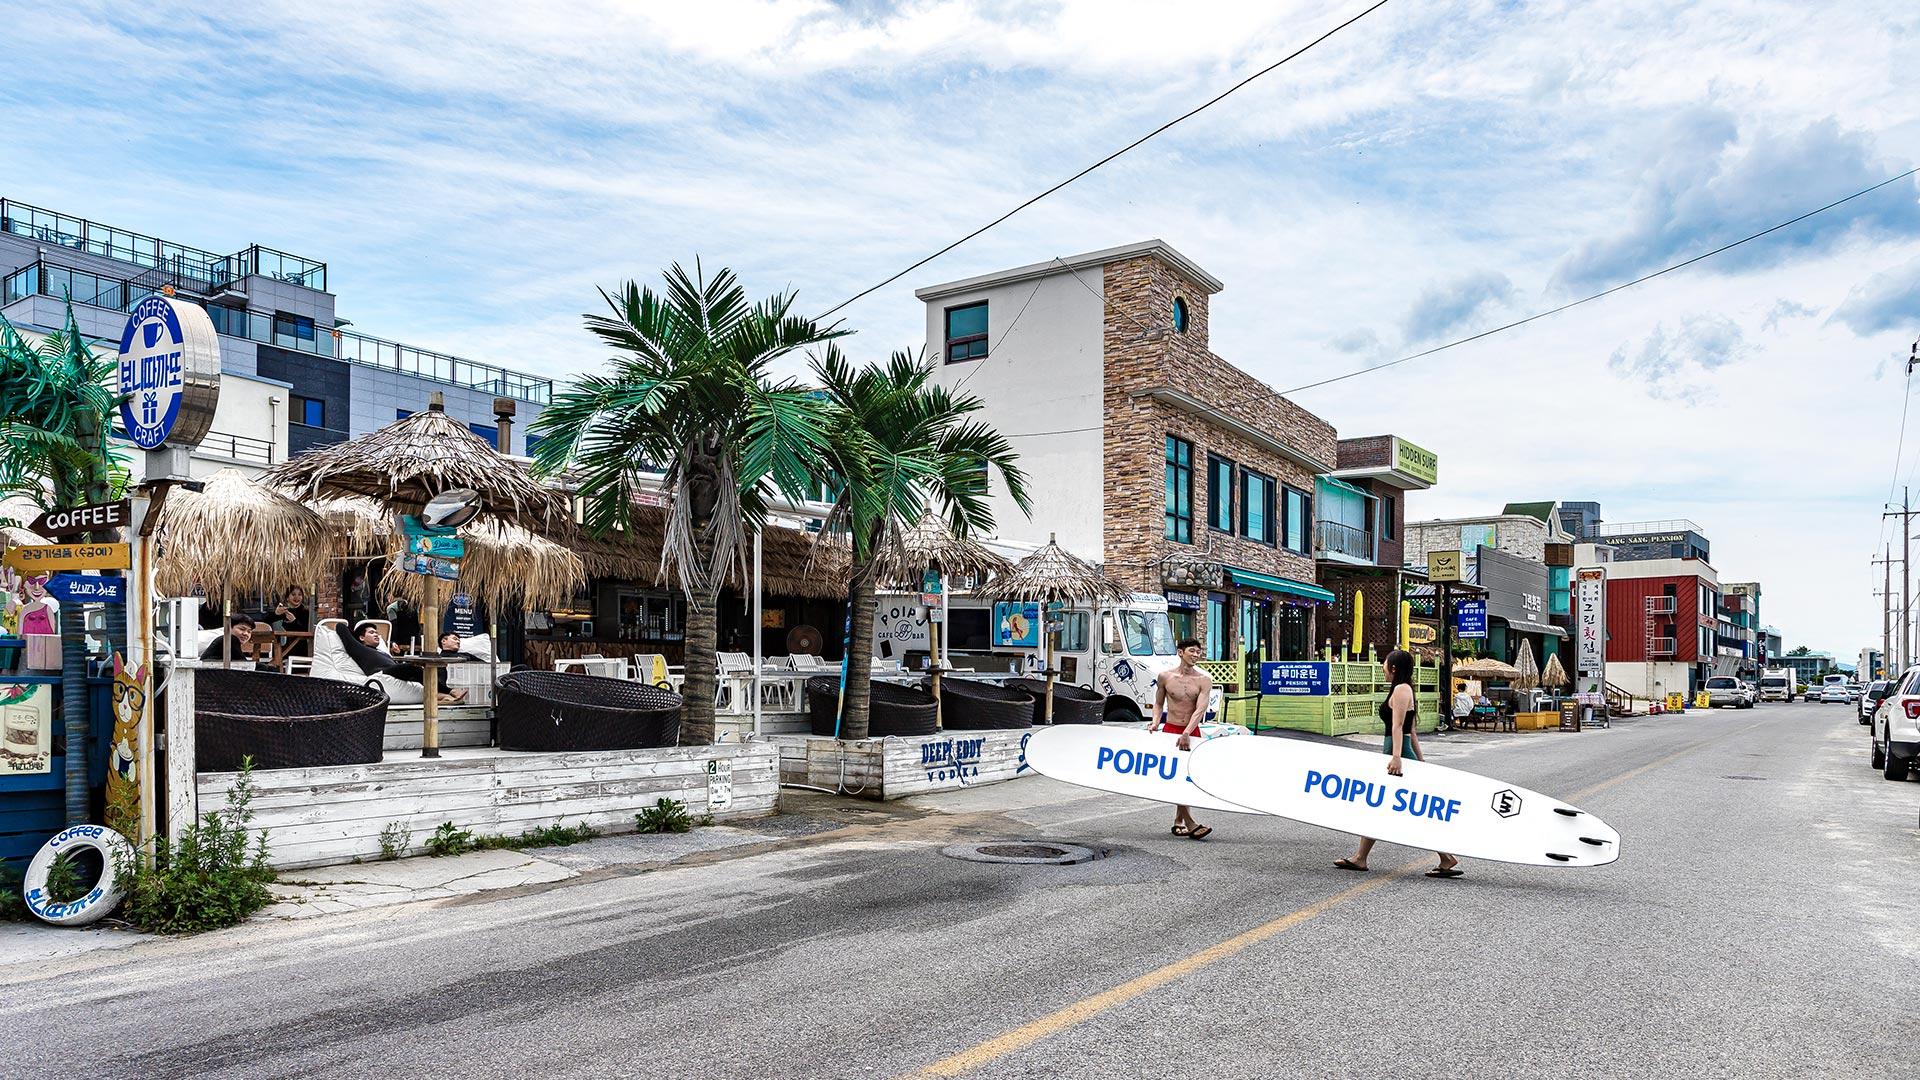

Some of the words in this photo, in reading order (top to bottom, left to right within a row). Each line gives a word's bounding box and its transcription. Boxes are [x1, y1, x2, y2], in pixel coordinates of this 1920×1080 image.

[132, 299, 170, 329] COFFEE
[134, 421, 166, 446] CRAFT
[1399, 443, 1422, 466] HIDDEN
[1422, 454, 1436, 471] SURF
[46, 504, 120, 530] COFFEE
[1583, 603, 1596, 654] 그린횟집
[1272, 669, 1318, 679] 블루마운틴
[922, 742, 950, 764] DEEP
[957, 739, 982, 760] EDDY
[1097, 746, 1178, 780] POIPU
[709, 761, 716, 773] 2
[718, 763, 731, 772] HOUR
[710, 774, 731, 784] PARKING
[927, 766, 979, 782] VODKA
[1304, 770, 1385, 807] POIPU
[1392, 788, 1462, 822] SURF
